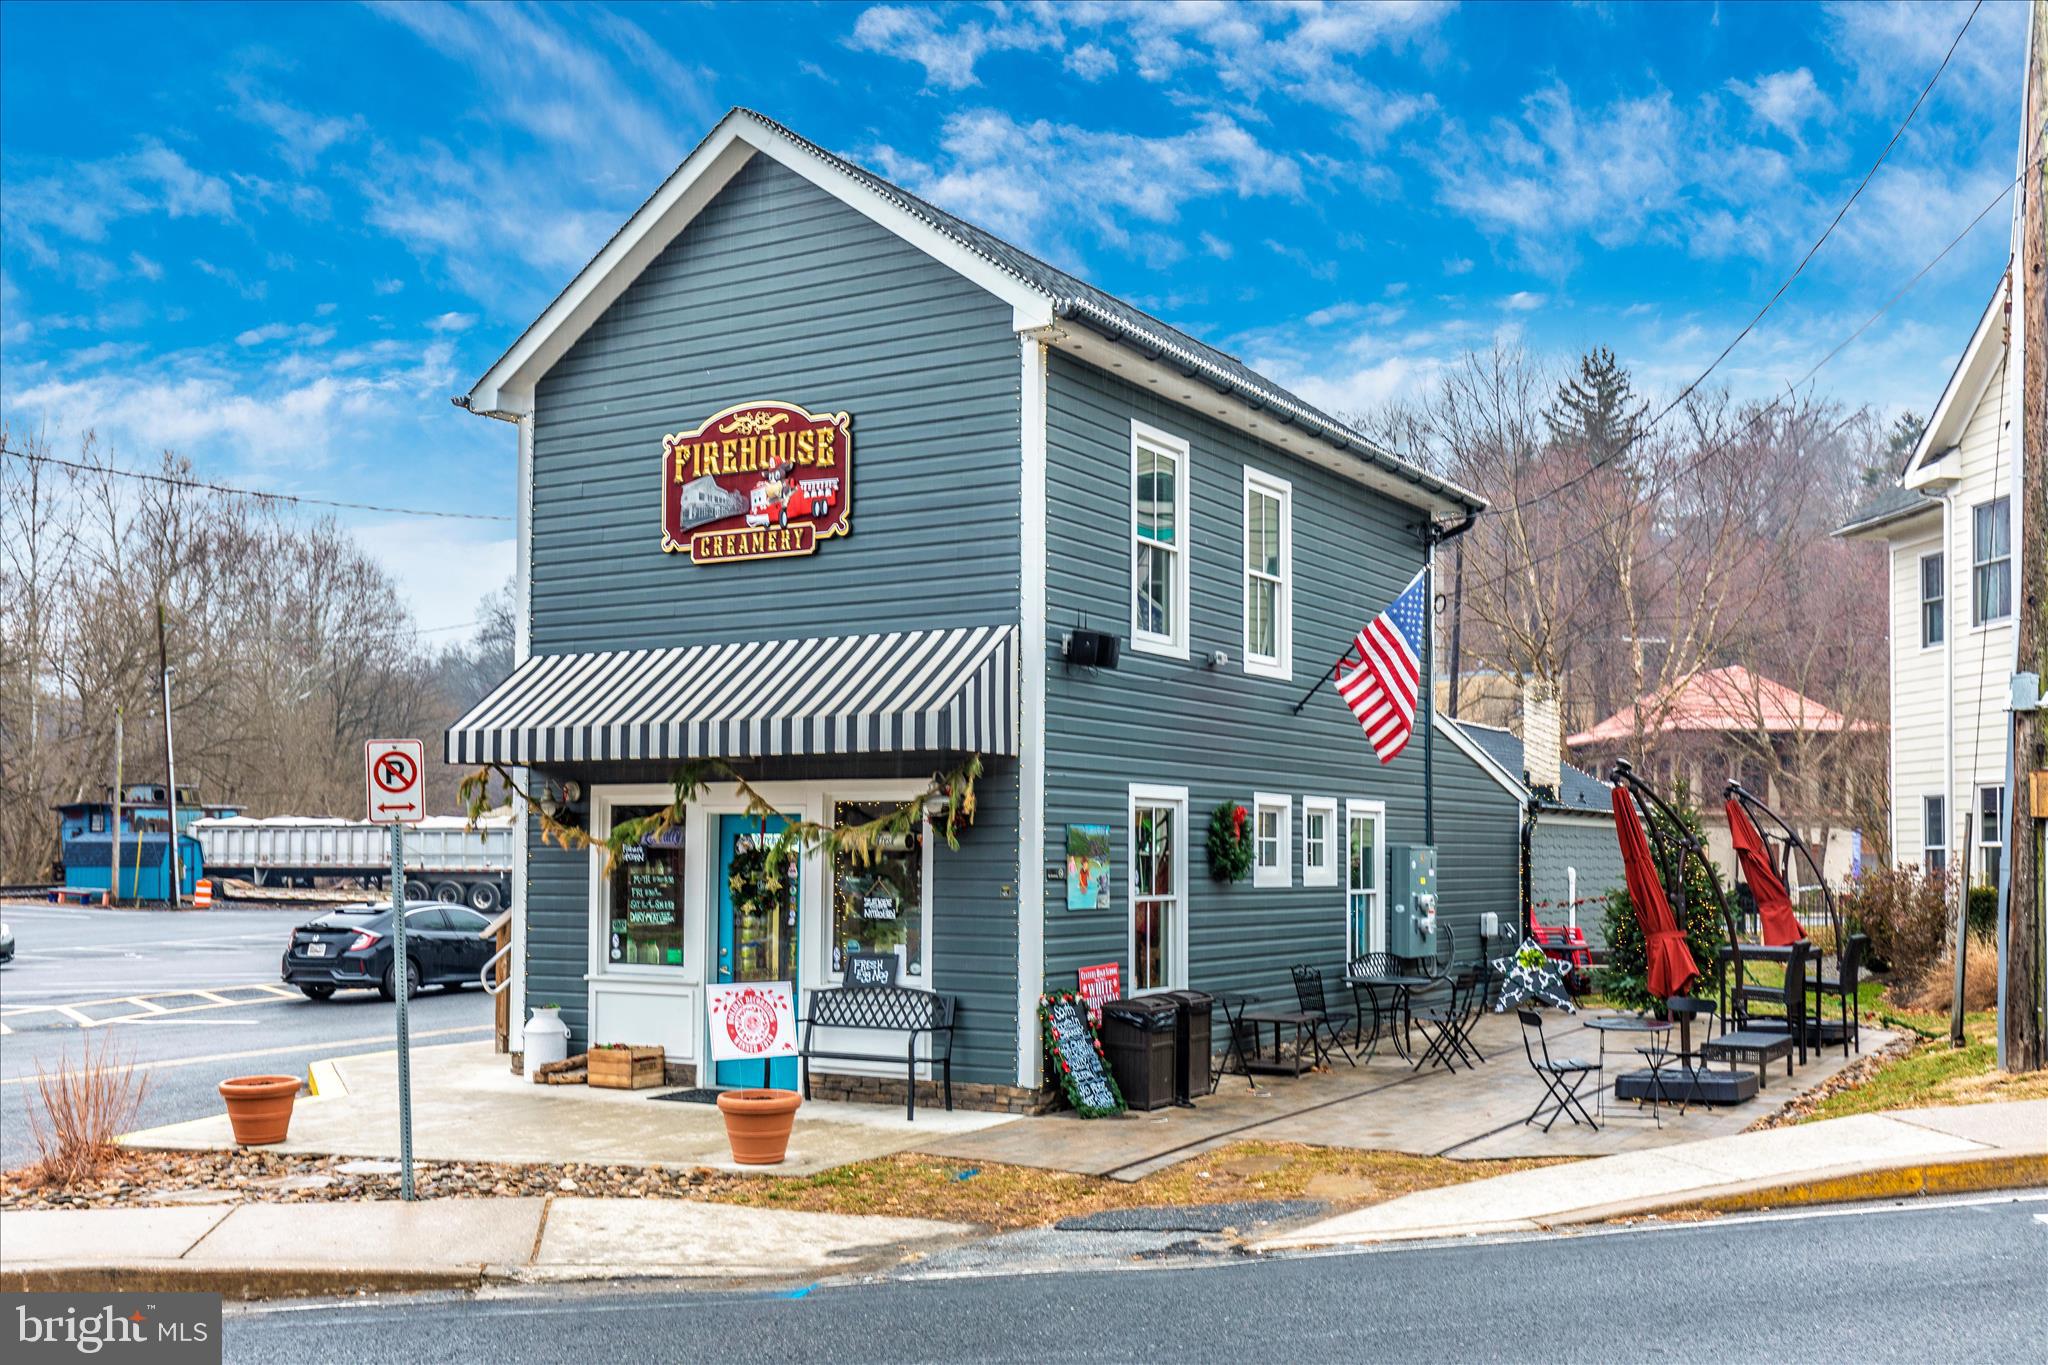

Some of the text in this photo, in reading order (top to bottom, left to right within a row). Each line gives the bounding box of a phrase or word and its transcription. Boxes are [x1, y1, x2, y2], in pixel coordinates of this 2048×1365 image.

[674, 427, 836, 483] FIREHOUSE
[700, 528, 805, 557] CREAMERY
[1088, 980, 1114, 998] WHITE
